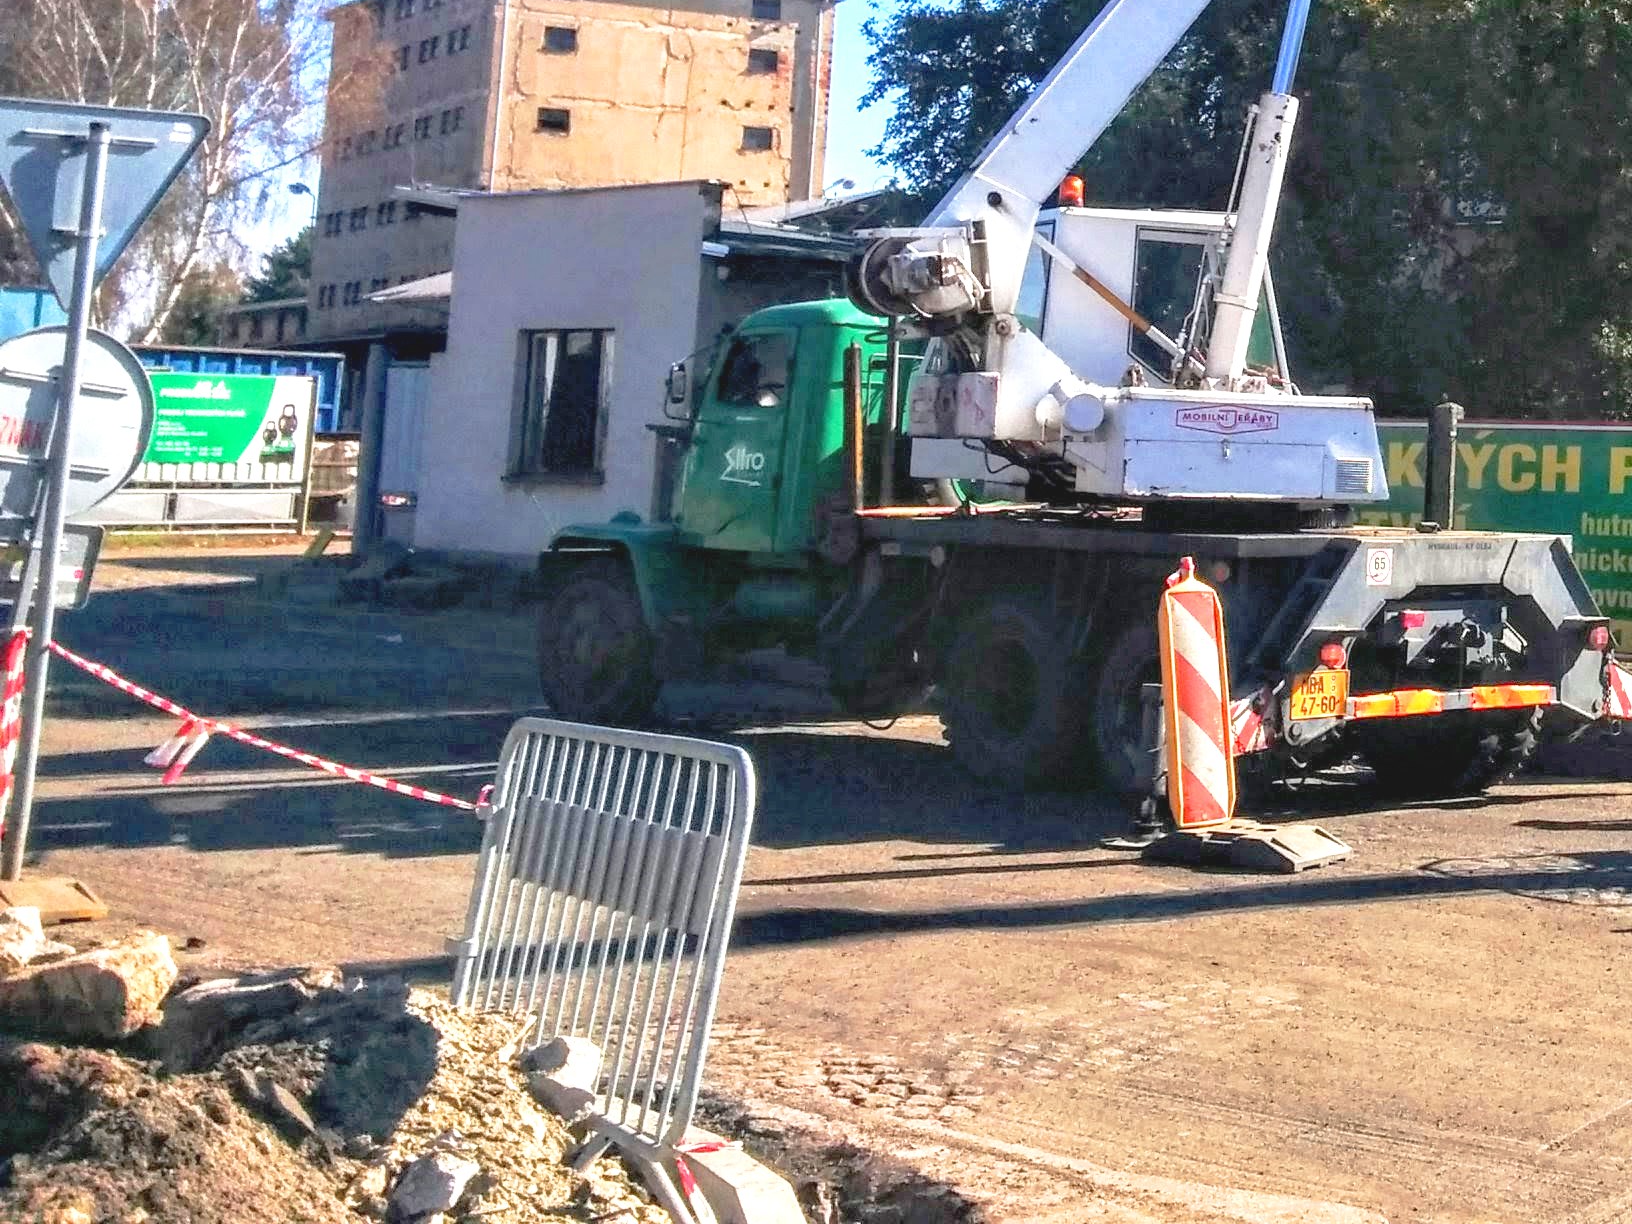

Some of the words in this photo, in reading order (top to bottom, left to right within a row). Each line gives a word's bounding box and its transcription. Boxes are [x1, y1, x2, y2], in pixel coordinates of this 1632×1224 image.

[1388, 429, 1582, 494] KÝCH
[1374, 557, 1386, 571] 65
[1300, 696, 1337, 716] 47-60
